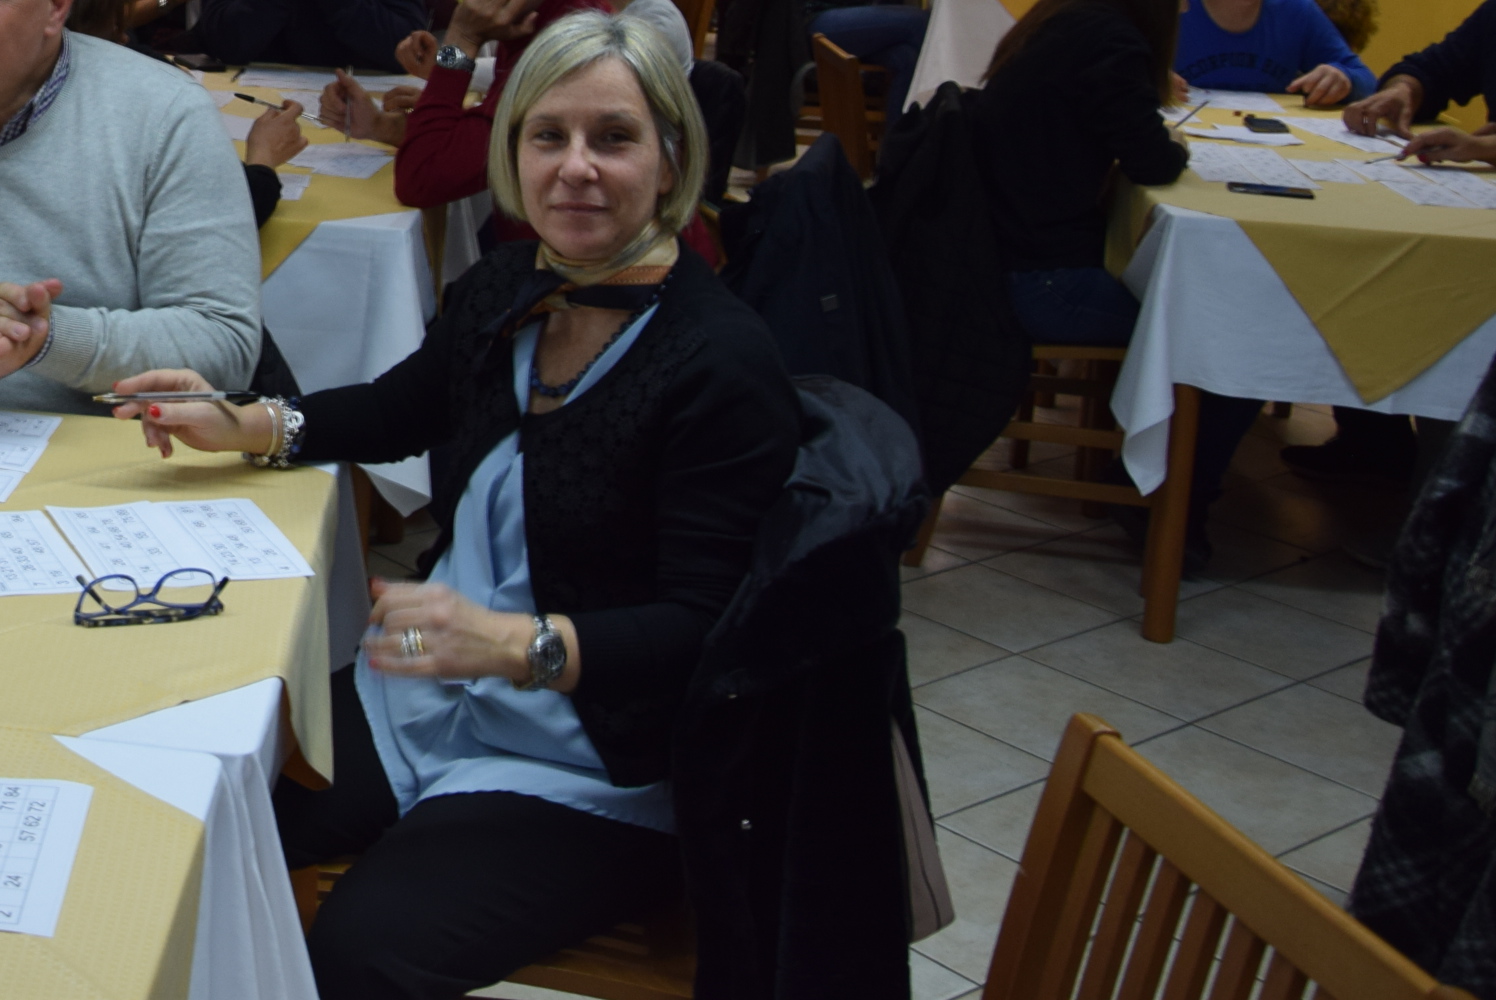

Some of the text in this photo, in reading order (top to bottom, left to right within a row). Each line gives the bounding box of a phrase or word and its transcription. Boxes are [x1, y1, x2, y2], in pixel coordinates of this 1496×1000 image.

[3, 786, 20, 798] 84
[26, 800, 46, 812] 72
[22, 815, 42, 827] 62
[17, 829, 35, 842] 57
[3, 875, 21, 888] 24
